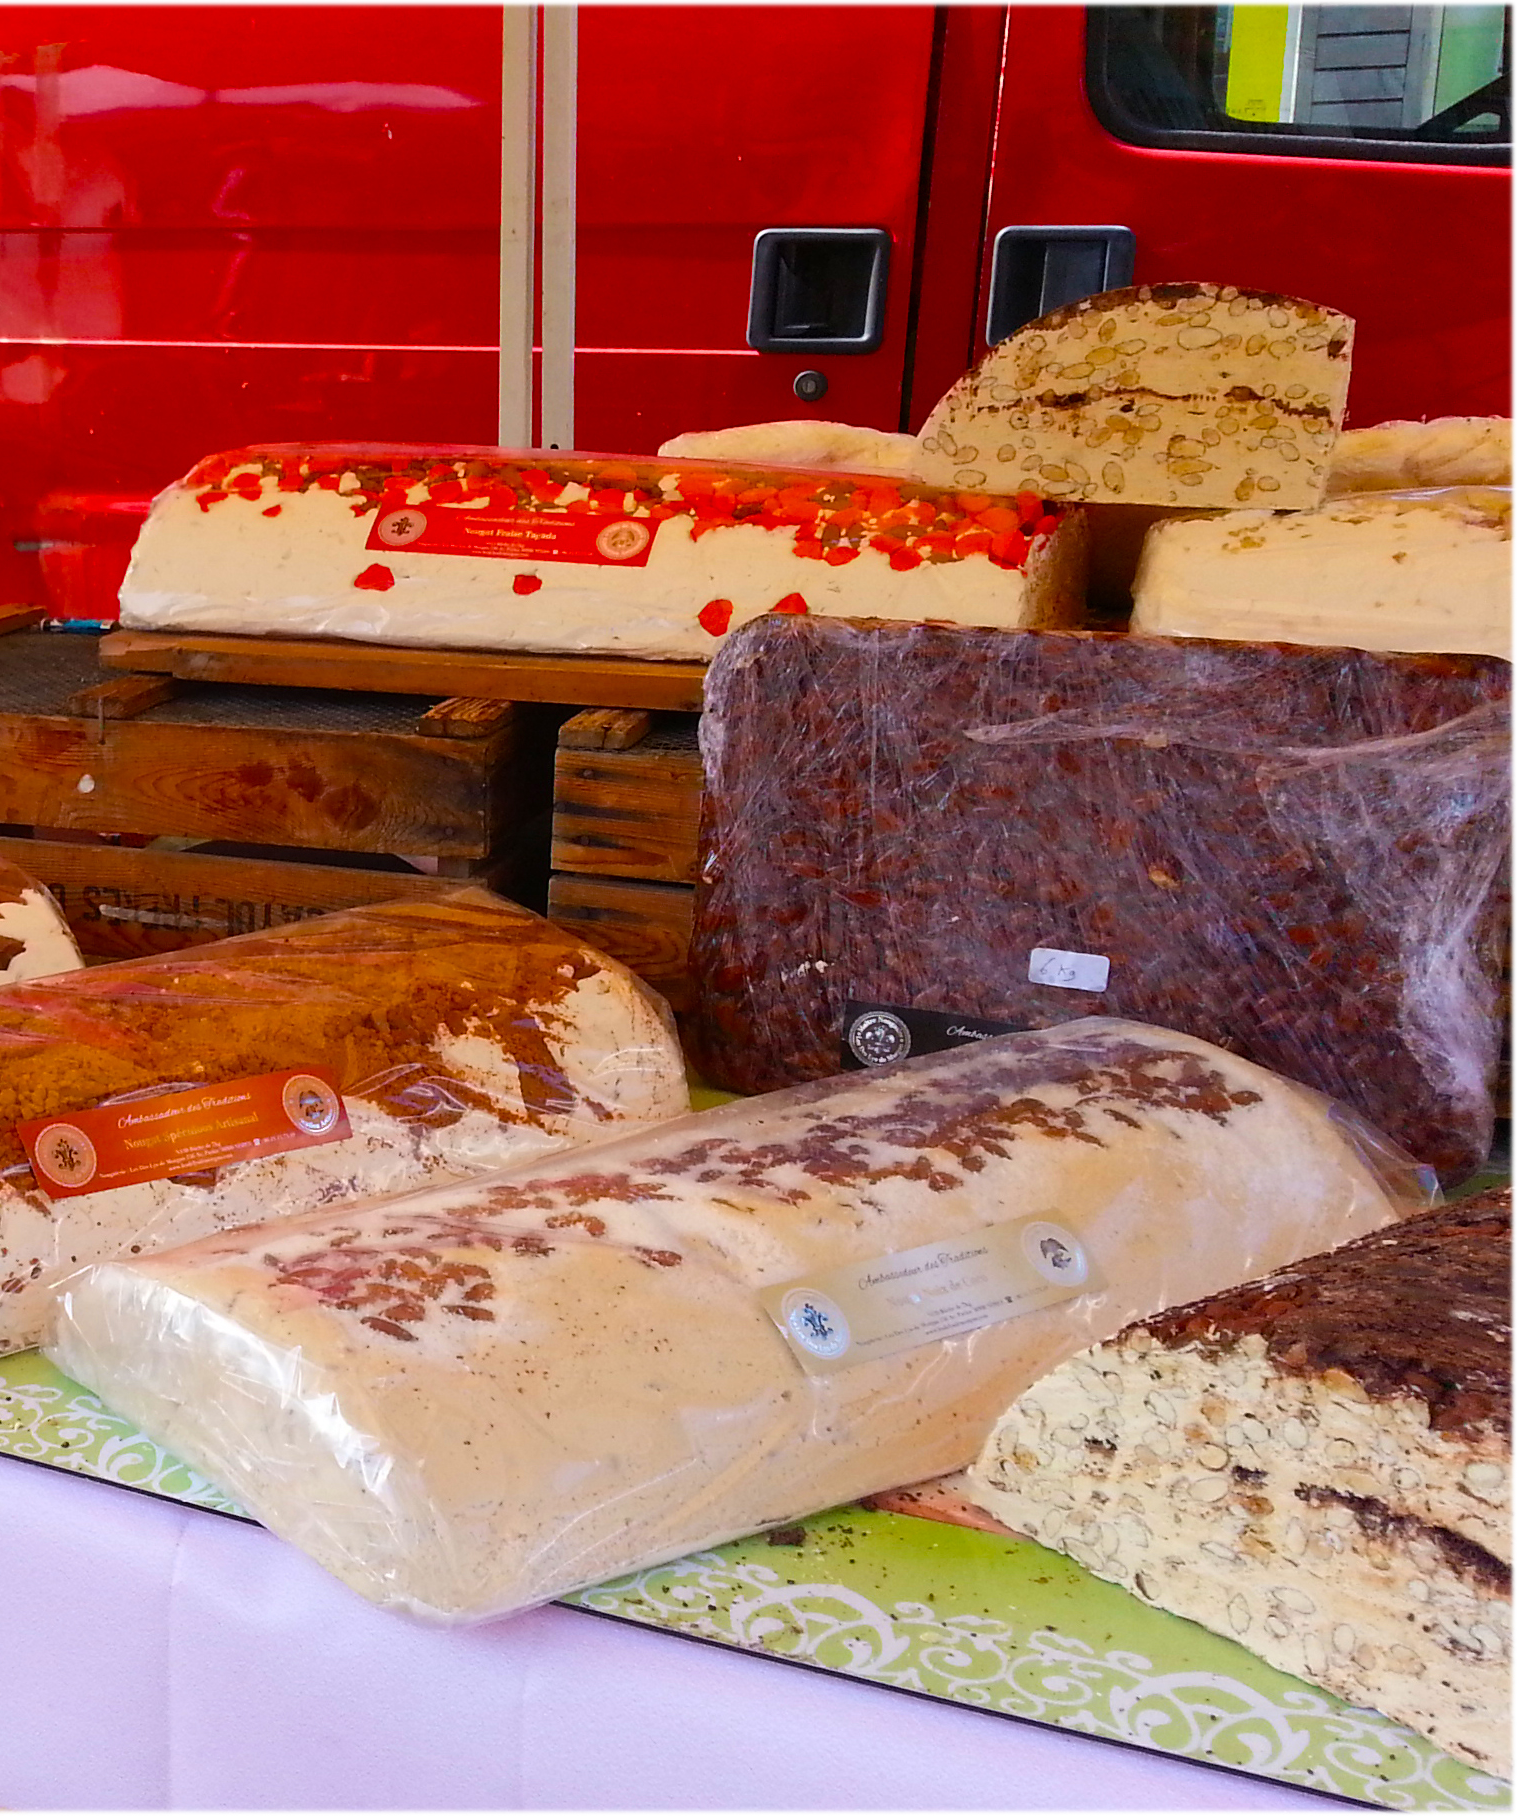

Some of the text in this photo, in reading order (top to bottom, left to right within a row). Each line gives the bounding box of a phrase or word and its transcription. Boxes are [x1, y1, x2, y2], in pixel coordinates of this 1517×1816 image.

[464, 527, 557, 541] Nougat Fraise Tagada
[1040, 957, 1056, 975] 6
[116, 1091, 252, 1128] Ambassadeur des Traditions
[123, 1133, 161, 1150] Nougat
[215, 1111, 259, 1128] Artisanal
[857, 1243, 990, 1291] Ambassadeur des Traditions
